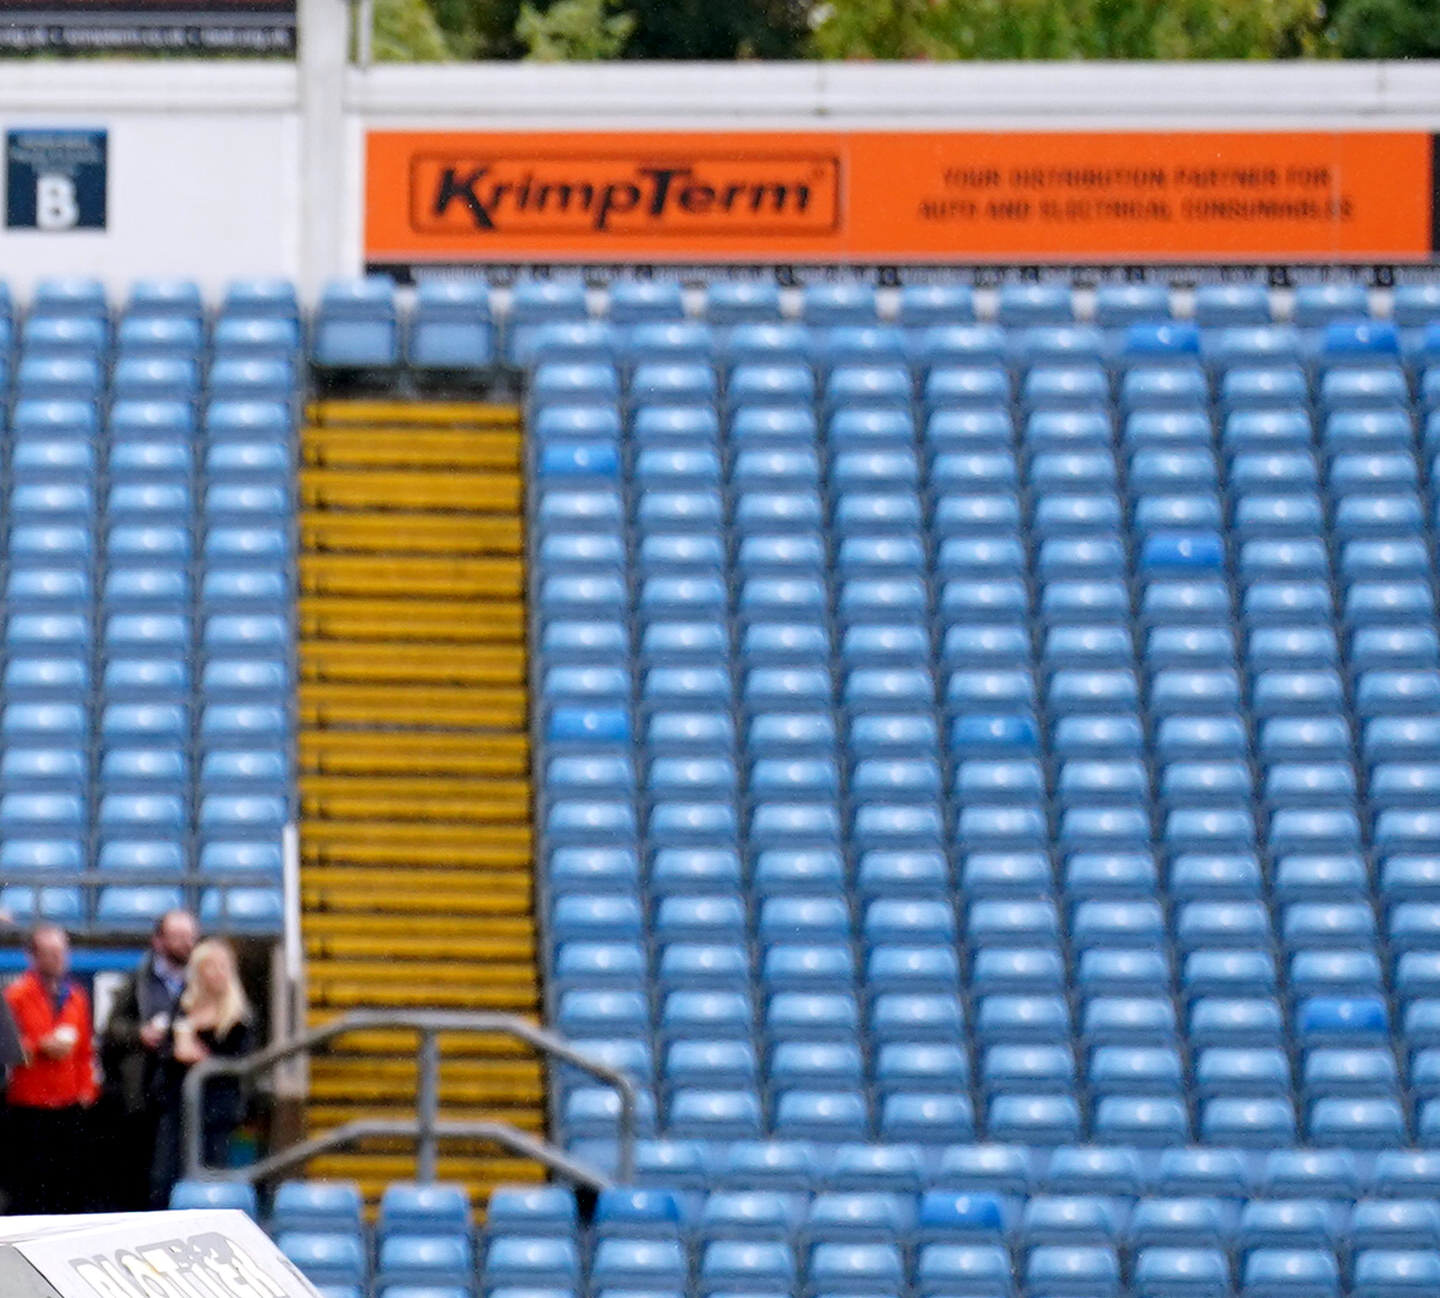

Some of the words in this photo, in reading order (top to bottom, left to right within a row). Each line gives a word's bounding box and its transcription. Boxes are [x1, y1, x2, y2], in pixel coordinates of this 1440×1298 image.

[429, 163, 814, 228] KrimpTerm
[943, 167, 1001, 189] YOUR
[1009, 167, 1167, 189] DISTRIBUTION
[1175, 167, 1278, 189] PARTNER
[1285, 167, 1332, 189] FOR
[36, 174, 81, 230] B
[918, 199, 977, 221] AUTO
[985, 199, 1032, 221] AND
